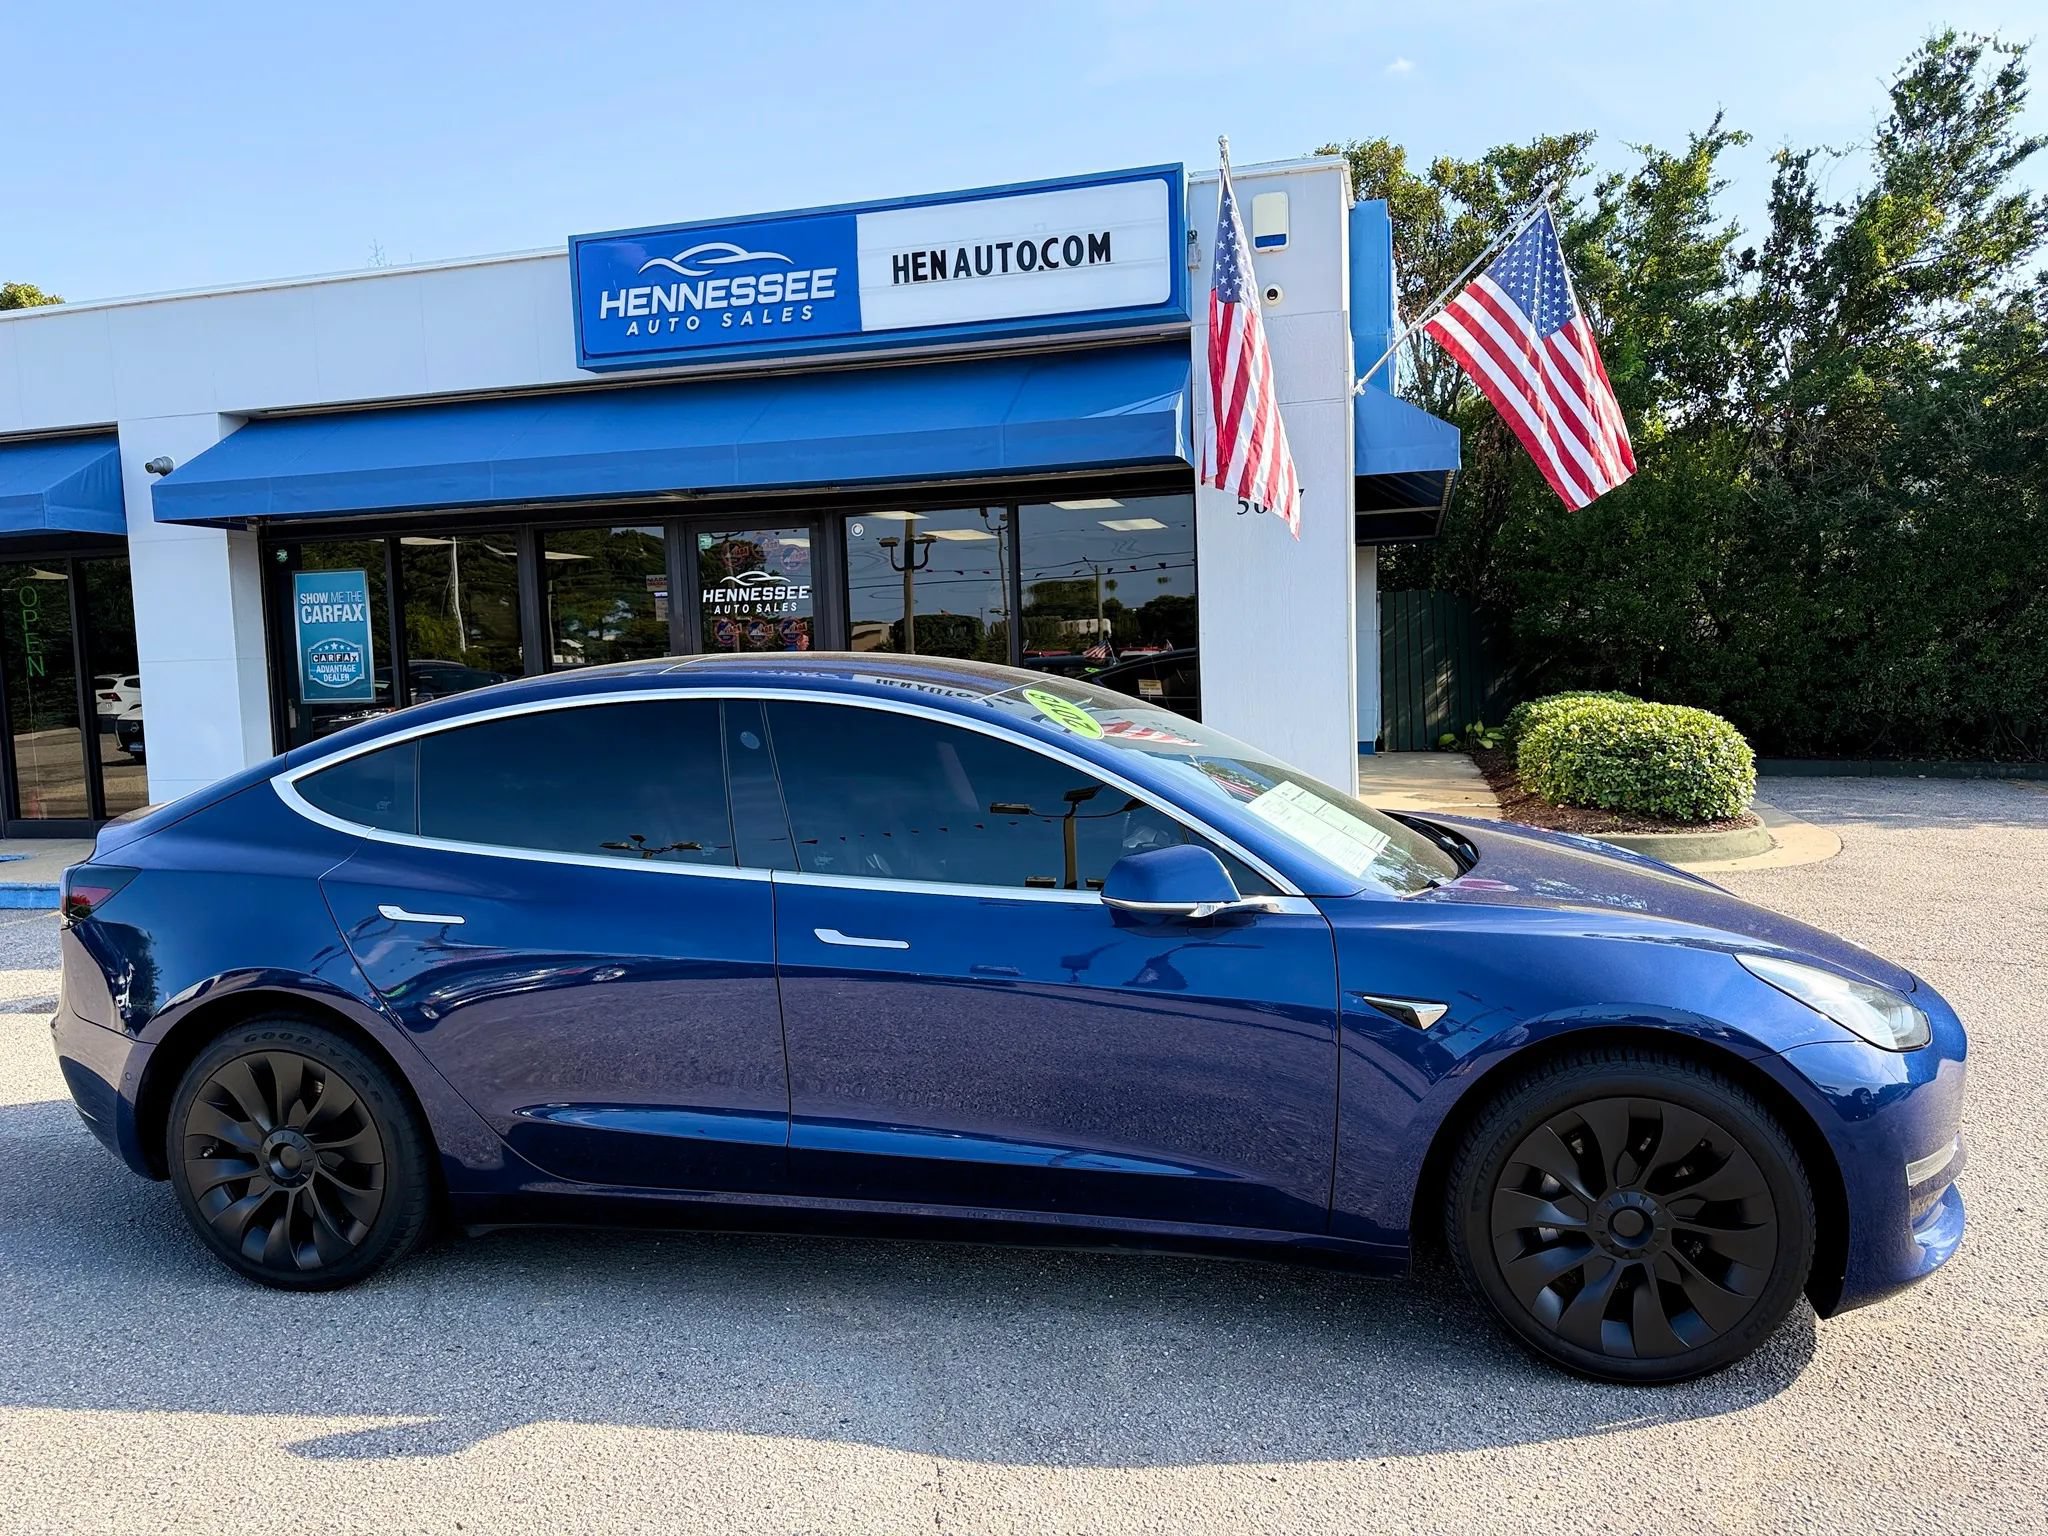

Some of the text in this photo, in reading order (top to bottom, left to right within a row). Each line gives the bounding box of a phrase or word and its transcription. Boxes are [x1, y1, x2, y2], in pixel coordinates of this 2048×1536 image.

[599, 267, 838, 319] HENNESSEE
[626, 305, 813, 336] AUTO SALES
[300, 591, 363, 605] SHOW ME THE
[702, 585, 811, 603] HENNESSEE
[301, 603, 365, 624] CARFAX
[713, 601, 798, 615] AUTO SALES
[20, 586, 45, 677] OPEN
[312, 653, 359, 663] CARFAX
[316, 664, 356, 673] ADVANTAGE
[323, 673, 350, 682] DEALER
